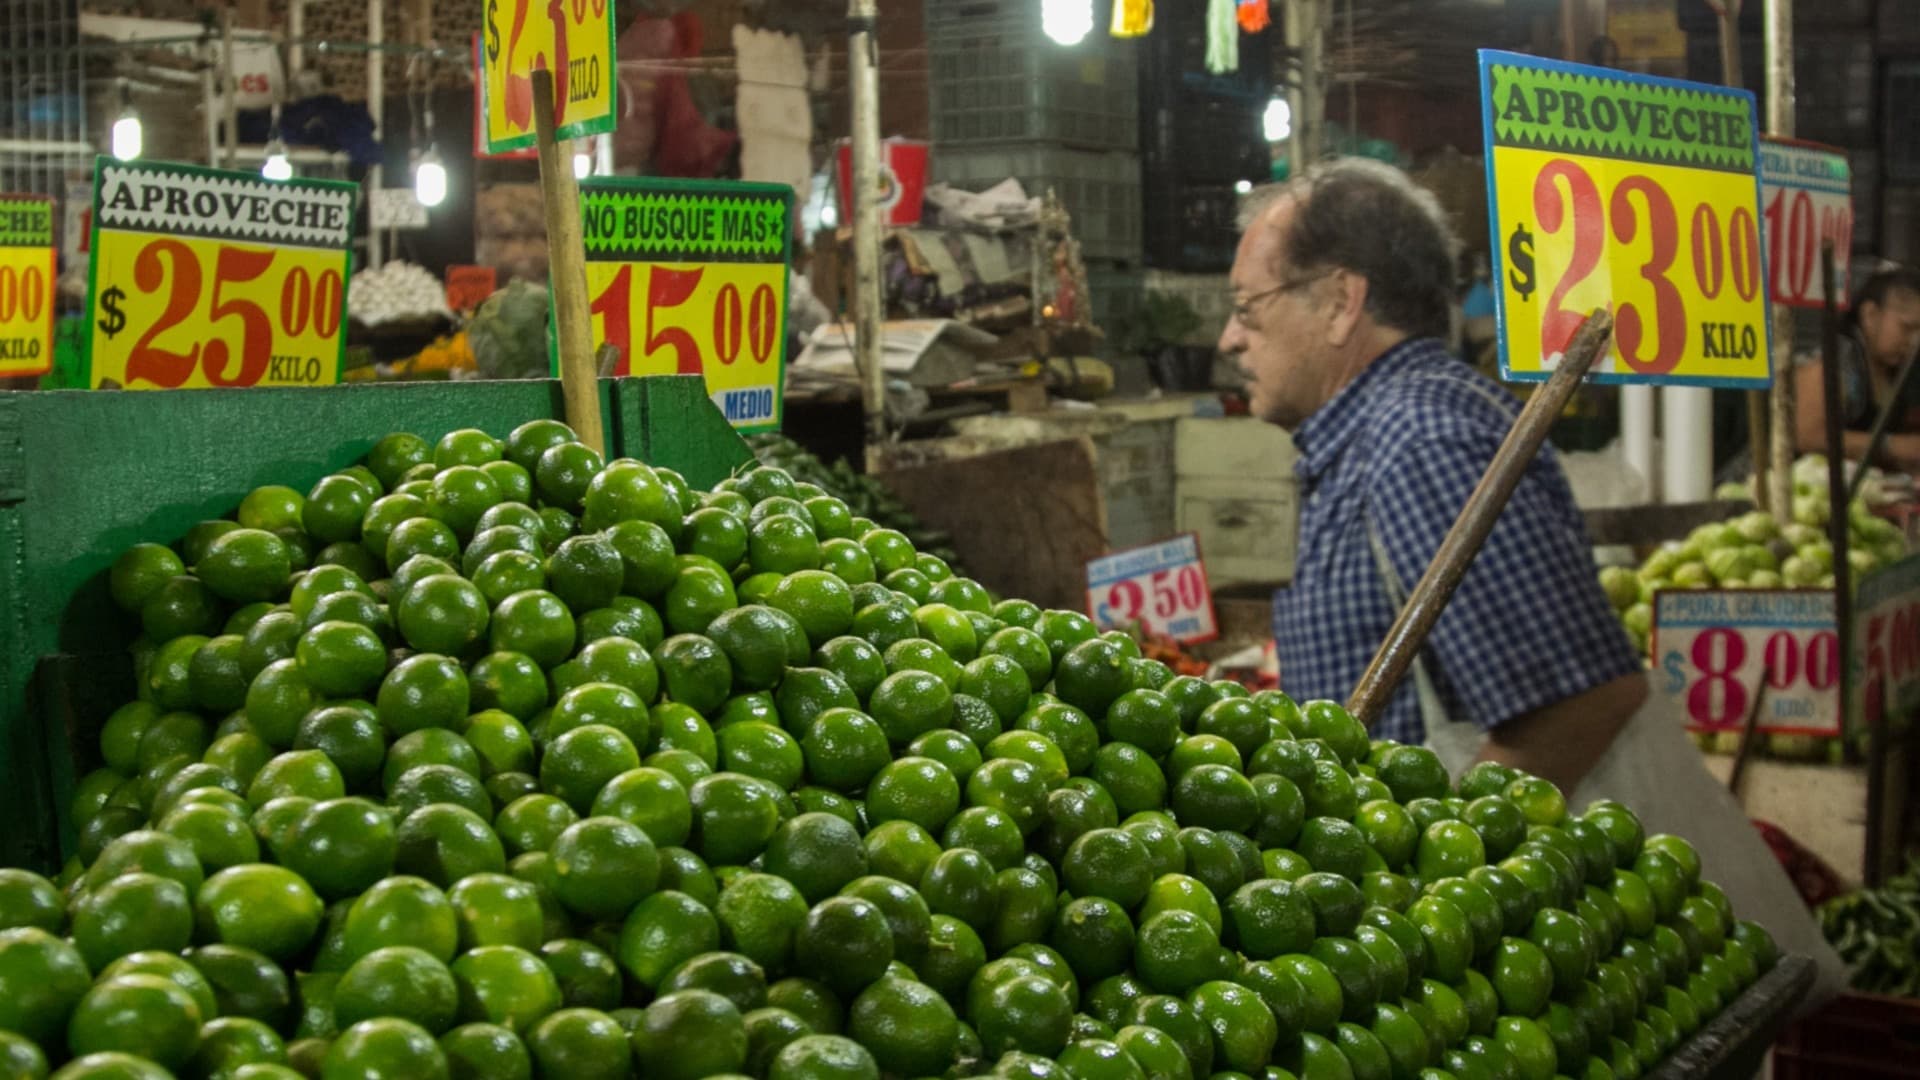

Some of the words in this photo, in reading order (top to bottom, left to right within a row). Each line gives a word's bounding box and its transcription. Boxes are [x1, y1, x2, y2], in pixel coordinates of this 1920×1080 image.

[569, 54, 600, 103] KILO
[1502, 82, 1748, 150] APROVECHE
[107, 178, 345, 232] APROVECHE
[583, 199, 618, 240] NO
[623, 204, 716, 243] BUSQUE
[722, 208, 767, 243] MAS
[1701, 322, 1757, 360] KILO
[269, 355, 321, 383] KILO
[725, 388, 773, 421] MEDIO
